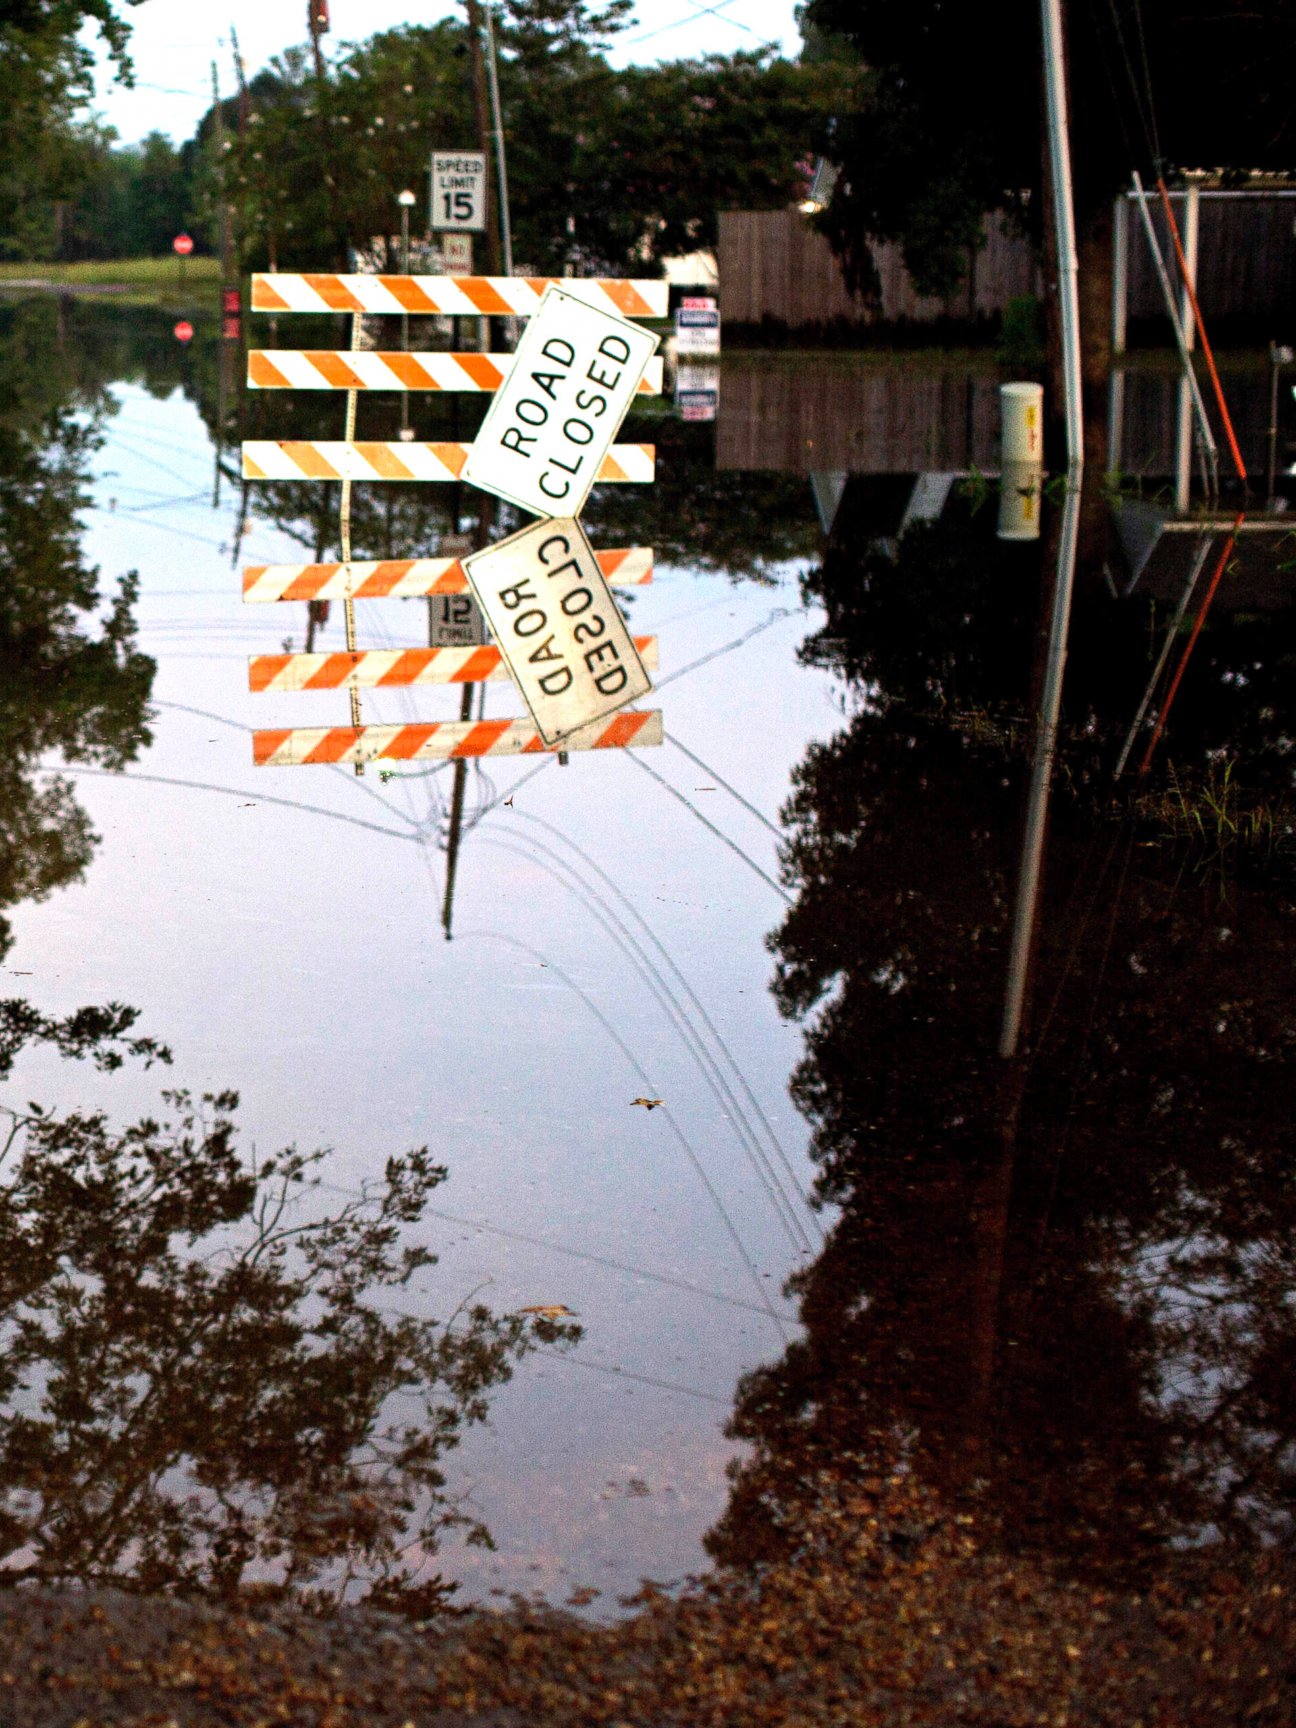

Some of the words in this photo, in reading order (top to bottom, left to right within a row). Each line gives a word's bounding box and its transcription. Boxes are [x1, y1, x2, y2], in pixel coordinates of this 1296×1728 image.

[436, 159, 483, 173] SPEED
[440, 176, 476, 189] LIMIT
[443, 192, 474, 220] 15
[501, 338, 575, 458] ROAD
[539, 335, 631, 499] CLOSED
